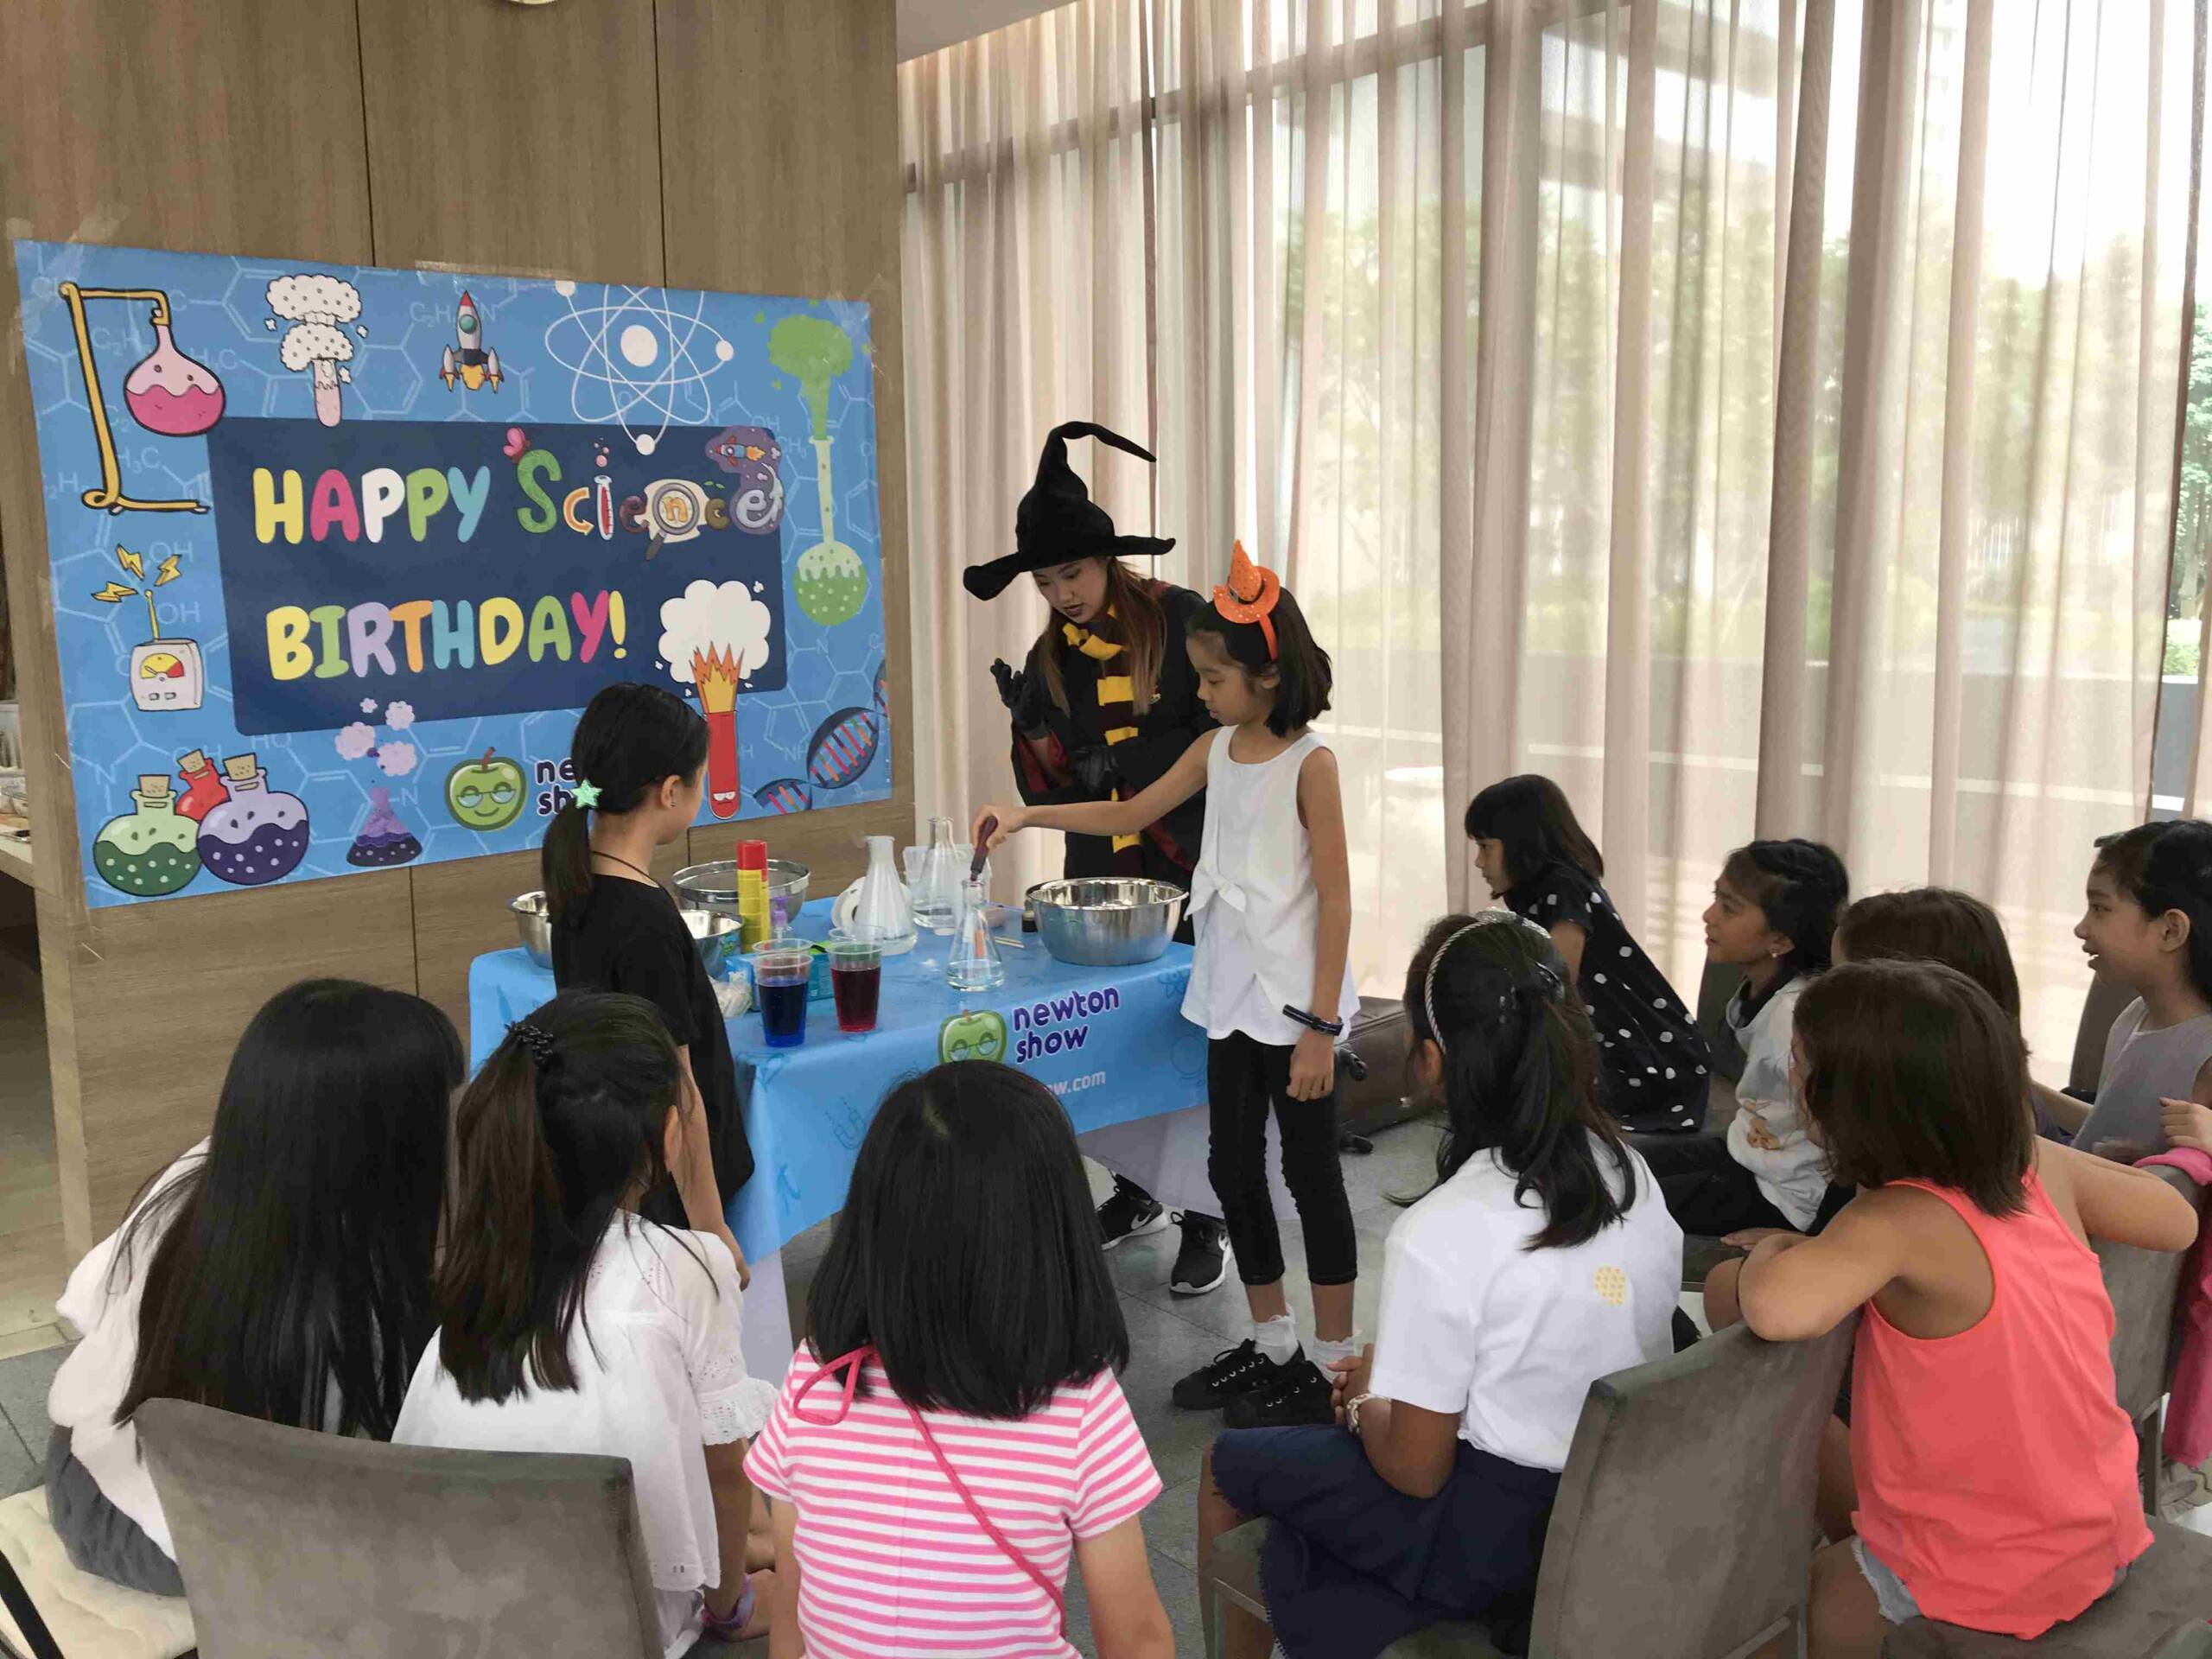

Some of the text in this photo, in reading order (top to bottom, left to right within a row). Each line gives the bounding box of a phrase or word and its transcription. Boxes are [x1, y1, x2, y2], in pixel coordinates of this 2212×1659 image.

[252, 448, 785, 545] HAPPY Science
[266, 590, 627, 681] BIRTHDAY!
[1012, 986, 1121, 1033] newton
[1014, 1025, 1090, 1065] show
